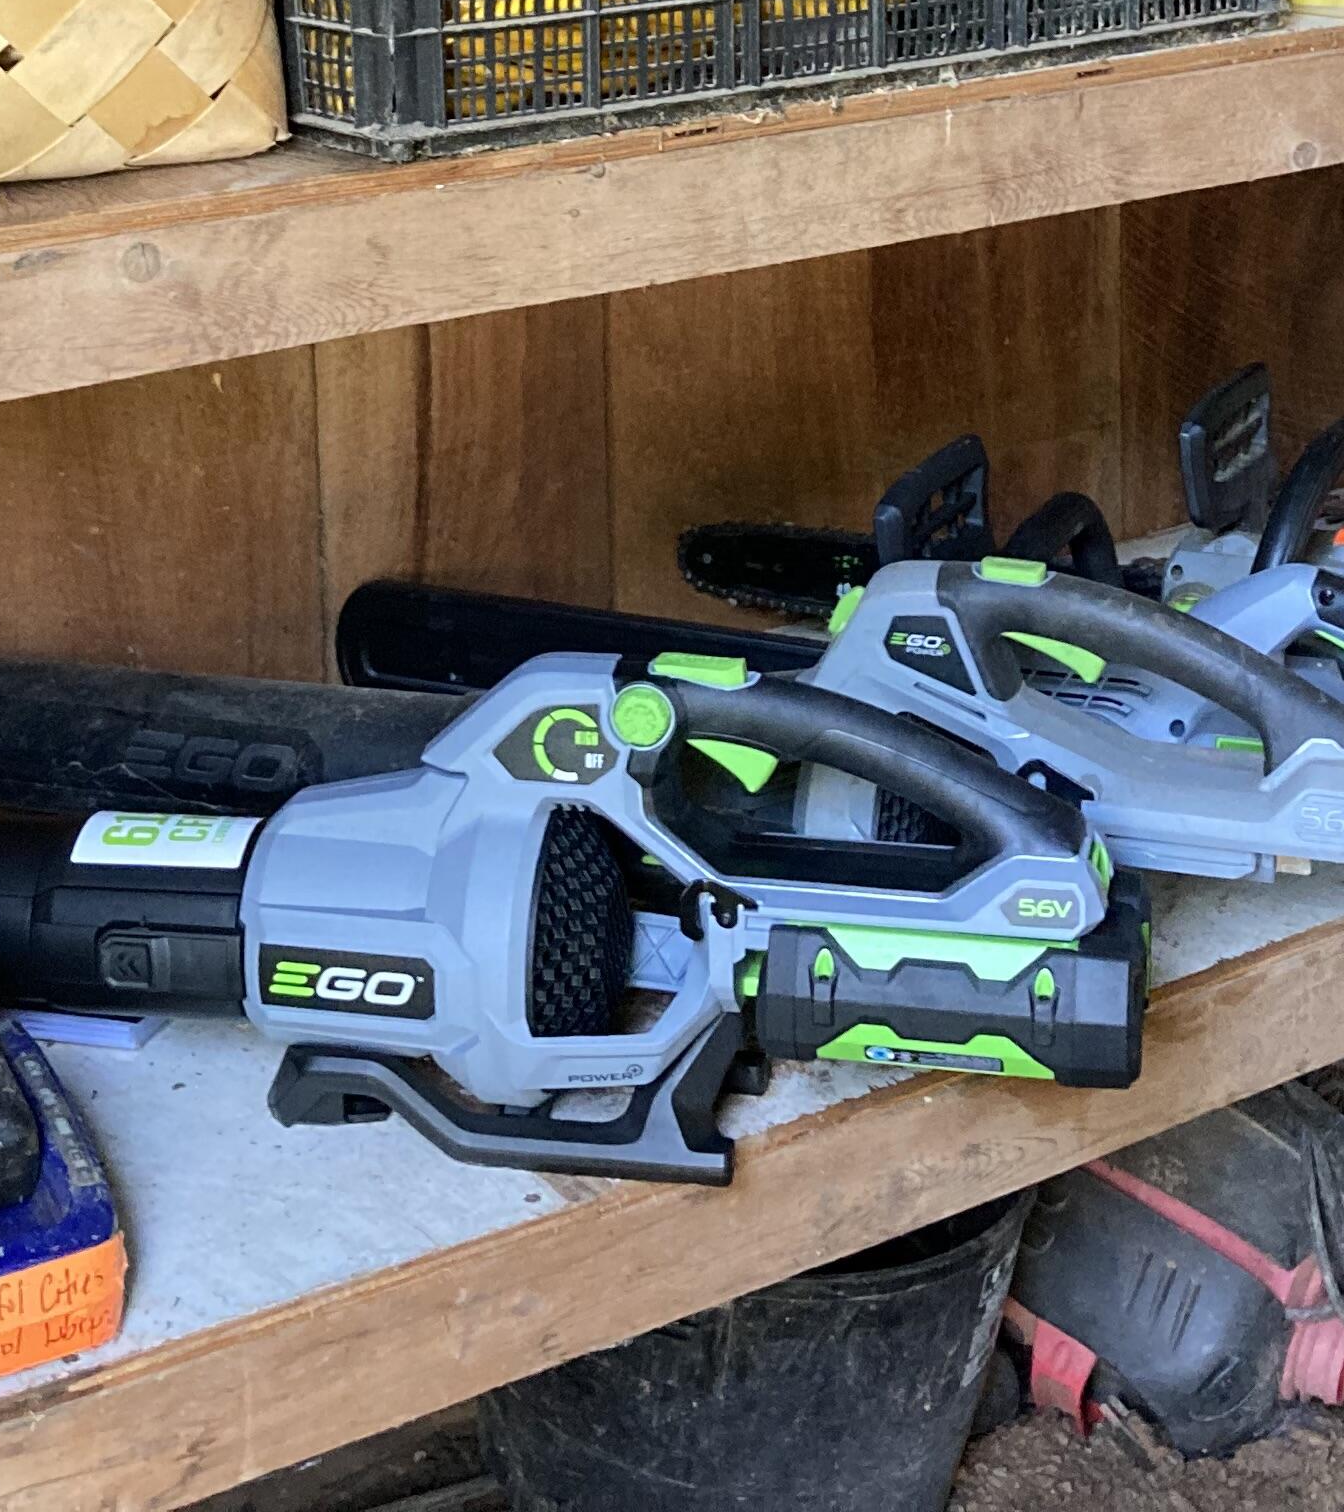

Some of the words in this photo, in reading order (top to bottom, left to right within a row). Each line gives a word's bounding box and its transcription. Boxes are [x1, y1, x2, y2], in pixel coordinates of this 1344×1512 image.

[889, 632, 943, 649] EGO
[124, 728, 299, 792] EGO
[102, 813, 171, 847] 61
[168, 815, 220, 843] CF
[1017, 898, 1073, 919] 56V
[269, 961, 416, 1006] EGO
[567, 1071, 634, 1084] POWER
